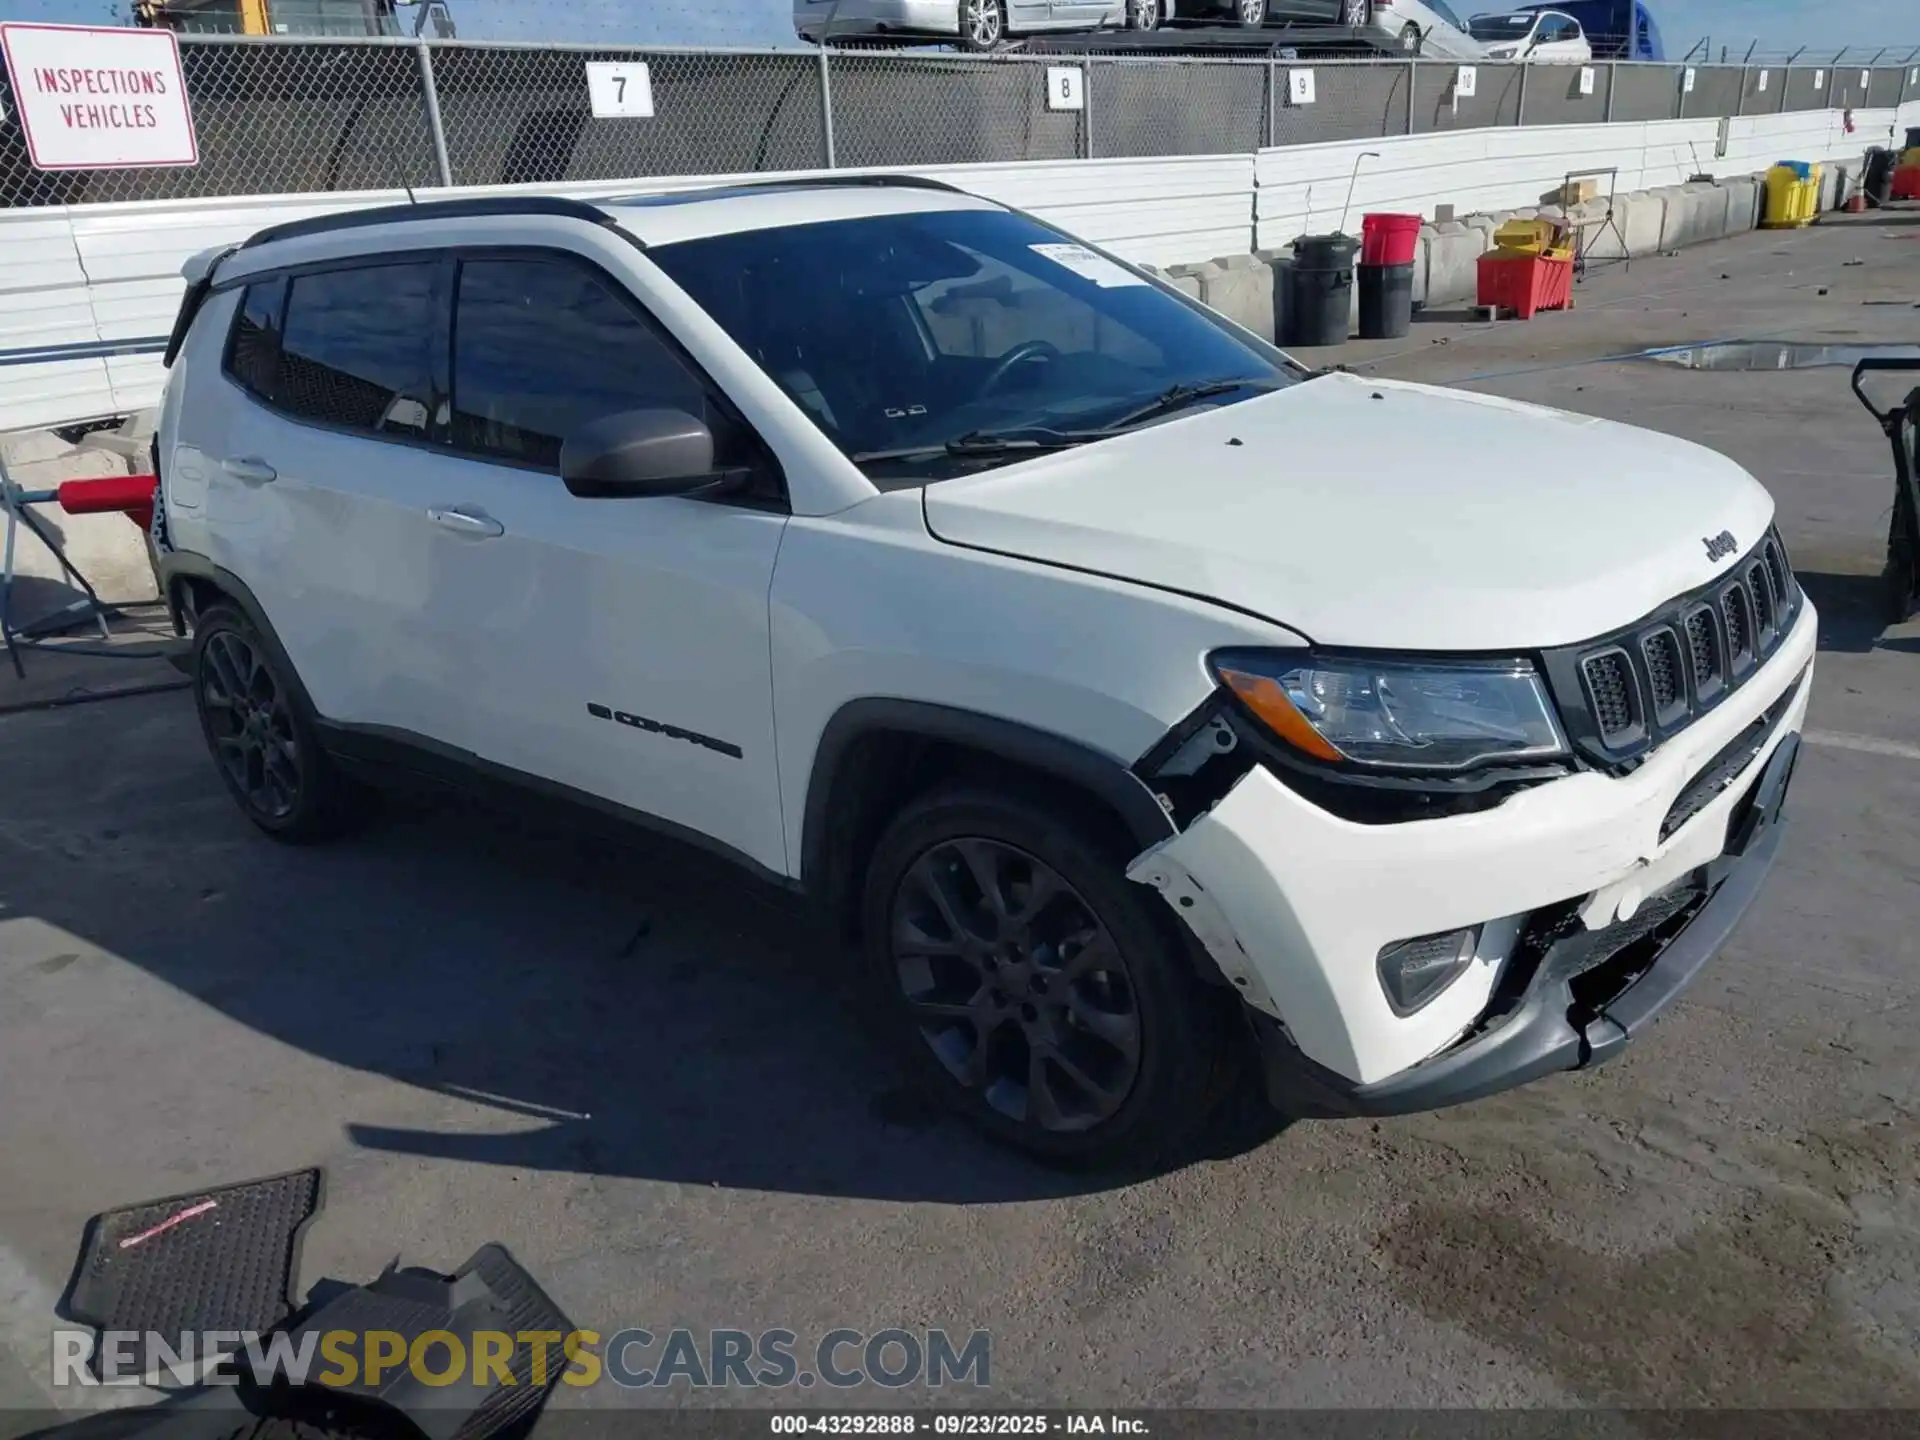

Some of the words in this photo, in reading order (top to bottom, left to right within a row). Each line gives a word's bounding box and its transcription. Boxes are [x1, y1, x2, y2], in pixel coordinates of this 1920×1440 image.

[34, 67, 166, 95] INSPECTIONS
[612, 76, 627, 103] 7
[1061, 78, 1070, 98] 8
[1299, 76, 1306, 95] 9
[60, 103, 157, 129] VEHICLES
[1702, 529, 1737, 563] Jeep
